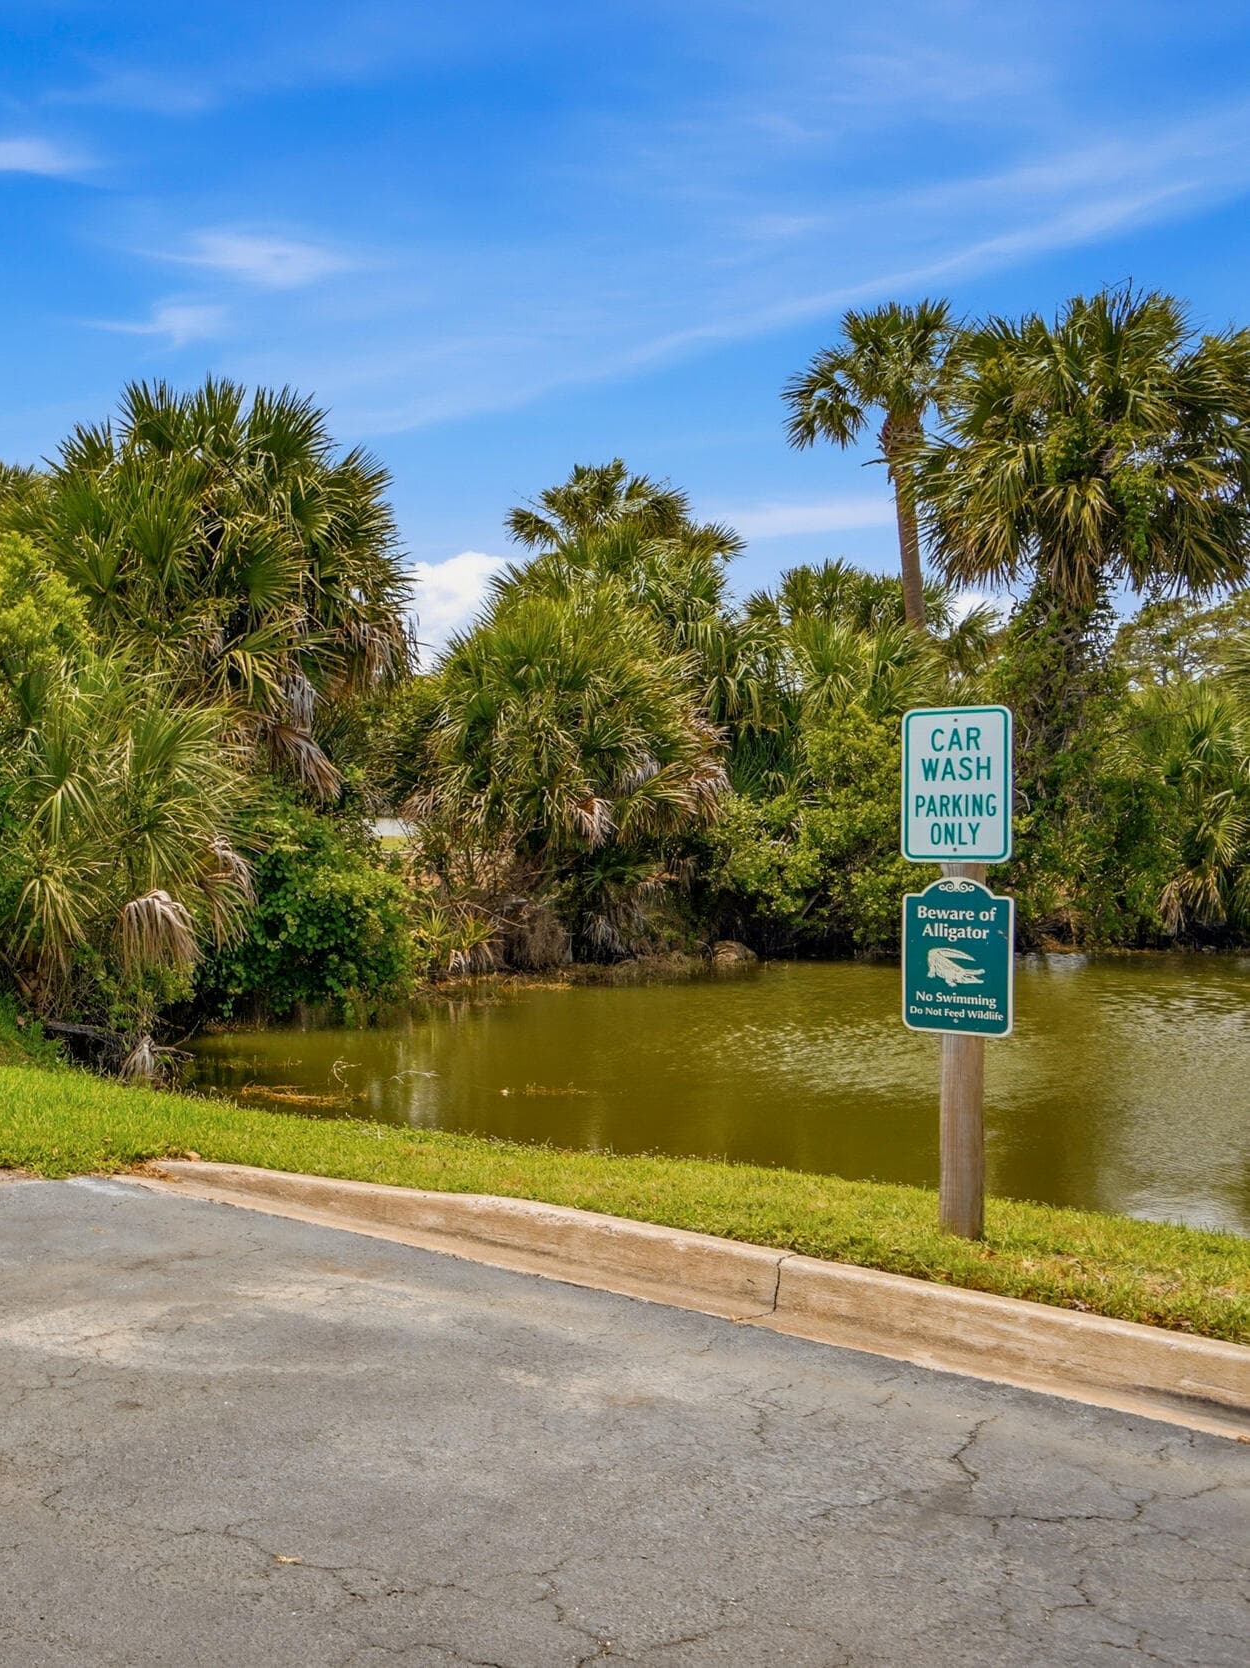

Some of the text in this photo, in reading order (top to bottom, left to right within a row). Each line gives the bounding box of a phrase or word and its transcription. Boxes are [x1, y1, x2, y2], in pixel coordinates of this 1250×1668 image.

[930, 727, 981, 752] CAR
[921, 756, 991, 781] WASH
[915, 794, 997, 817] PARKING
[930, 822, 980, 845] ONLY
[917, 905, 997, 921] Beware of
[922, 923, 989, 942] Alligator
[916, 991, 997, 1009] No Swimming
[910, 1006, 1004, 1021] Do Not Feed Wildlife
